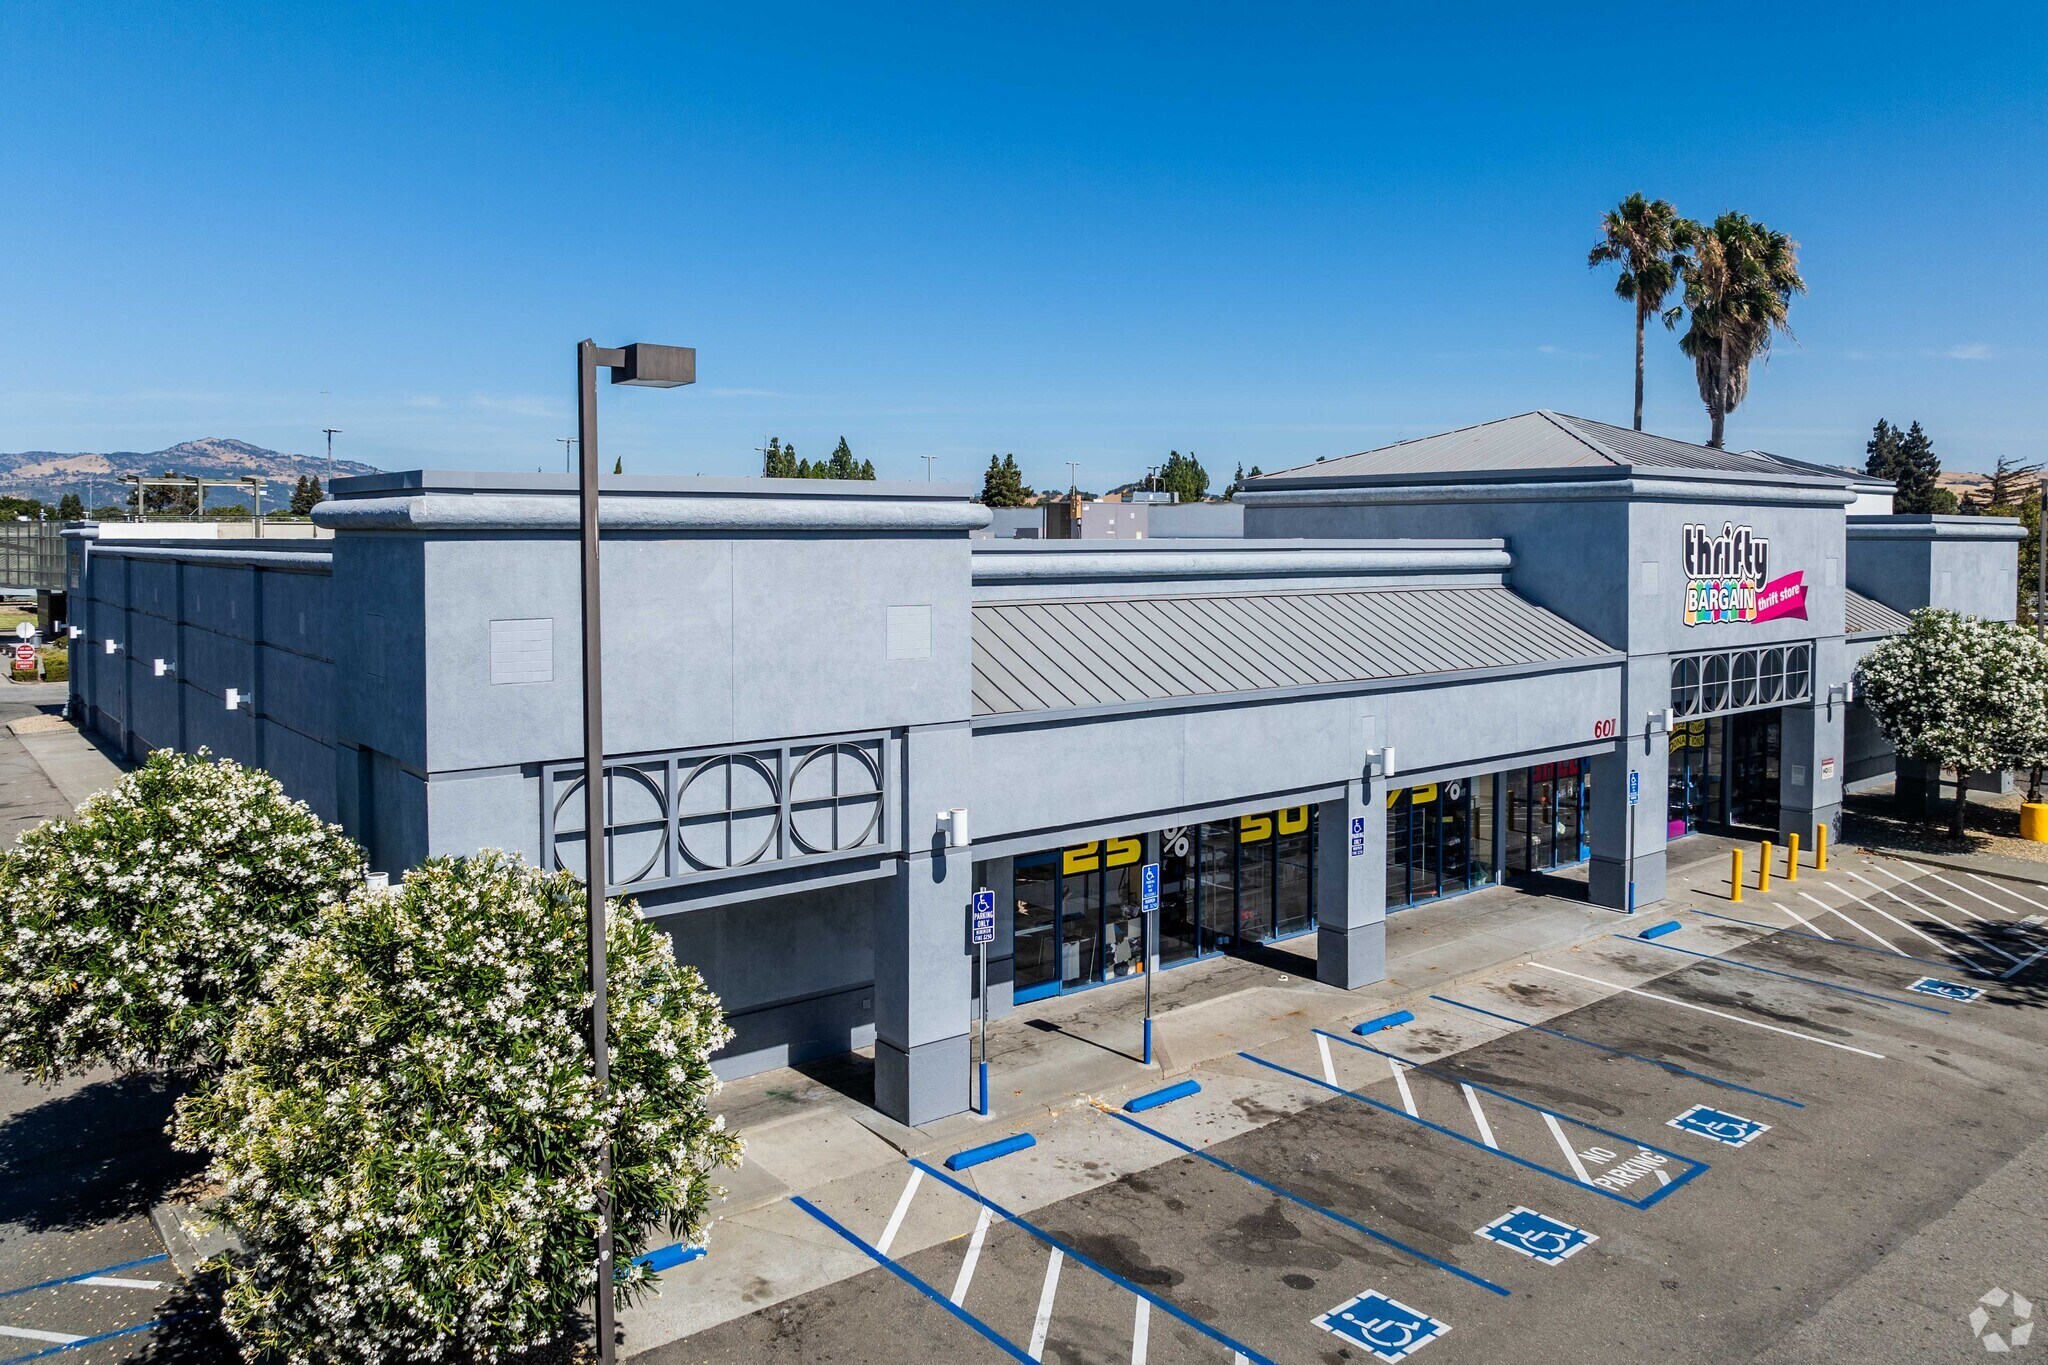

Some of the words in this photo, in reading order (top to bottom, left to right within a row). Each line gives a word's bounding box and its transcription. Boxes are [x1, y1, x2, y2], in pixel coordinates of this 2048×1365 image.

[1683, 521, 1769, 593] thrifty
[1688, 587, 1754, 612] BARGAIN
[1758, 594, 1779, 611] thrift
[1780, 584, 1800, 601] store
[1594, 718, 1616, 738] 601
[974, 911, 994, 920] PARKING
[977, 920, 990, 928] ONLY
[1578, 1146, 1617, 1165] NO
[1593, 1151, 1668, 1191] PARKING
